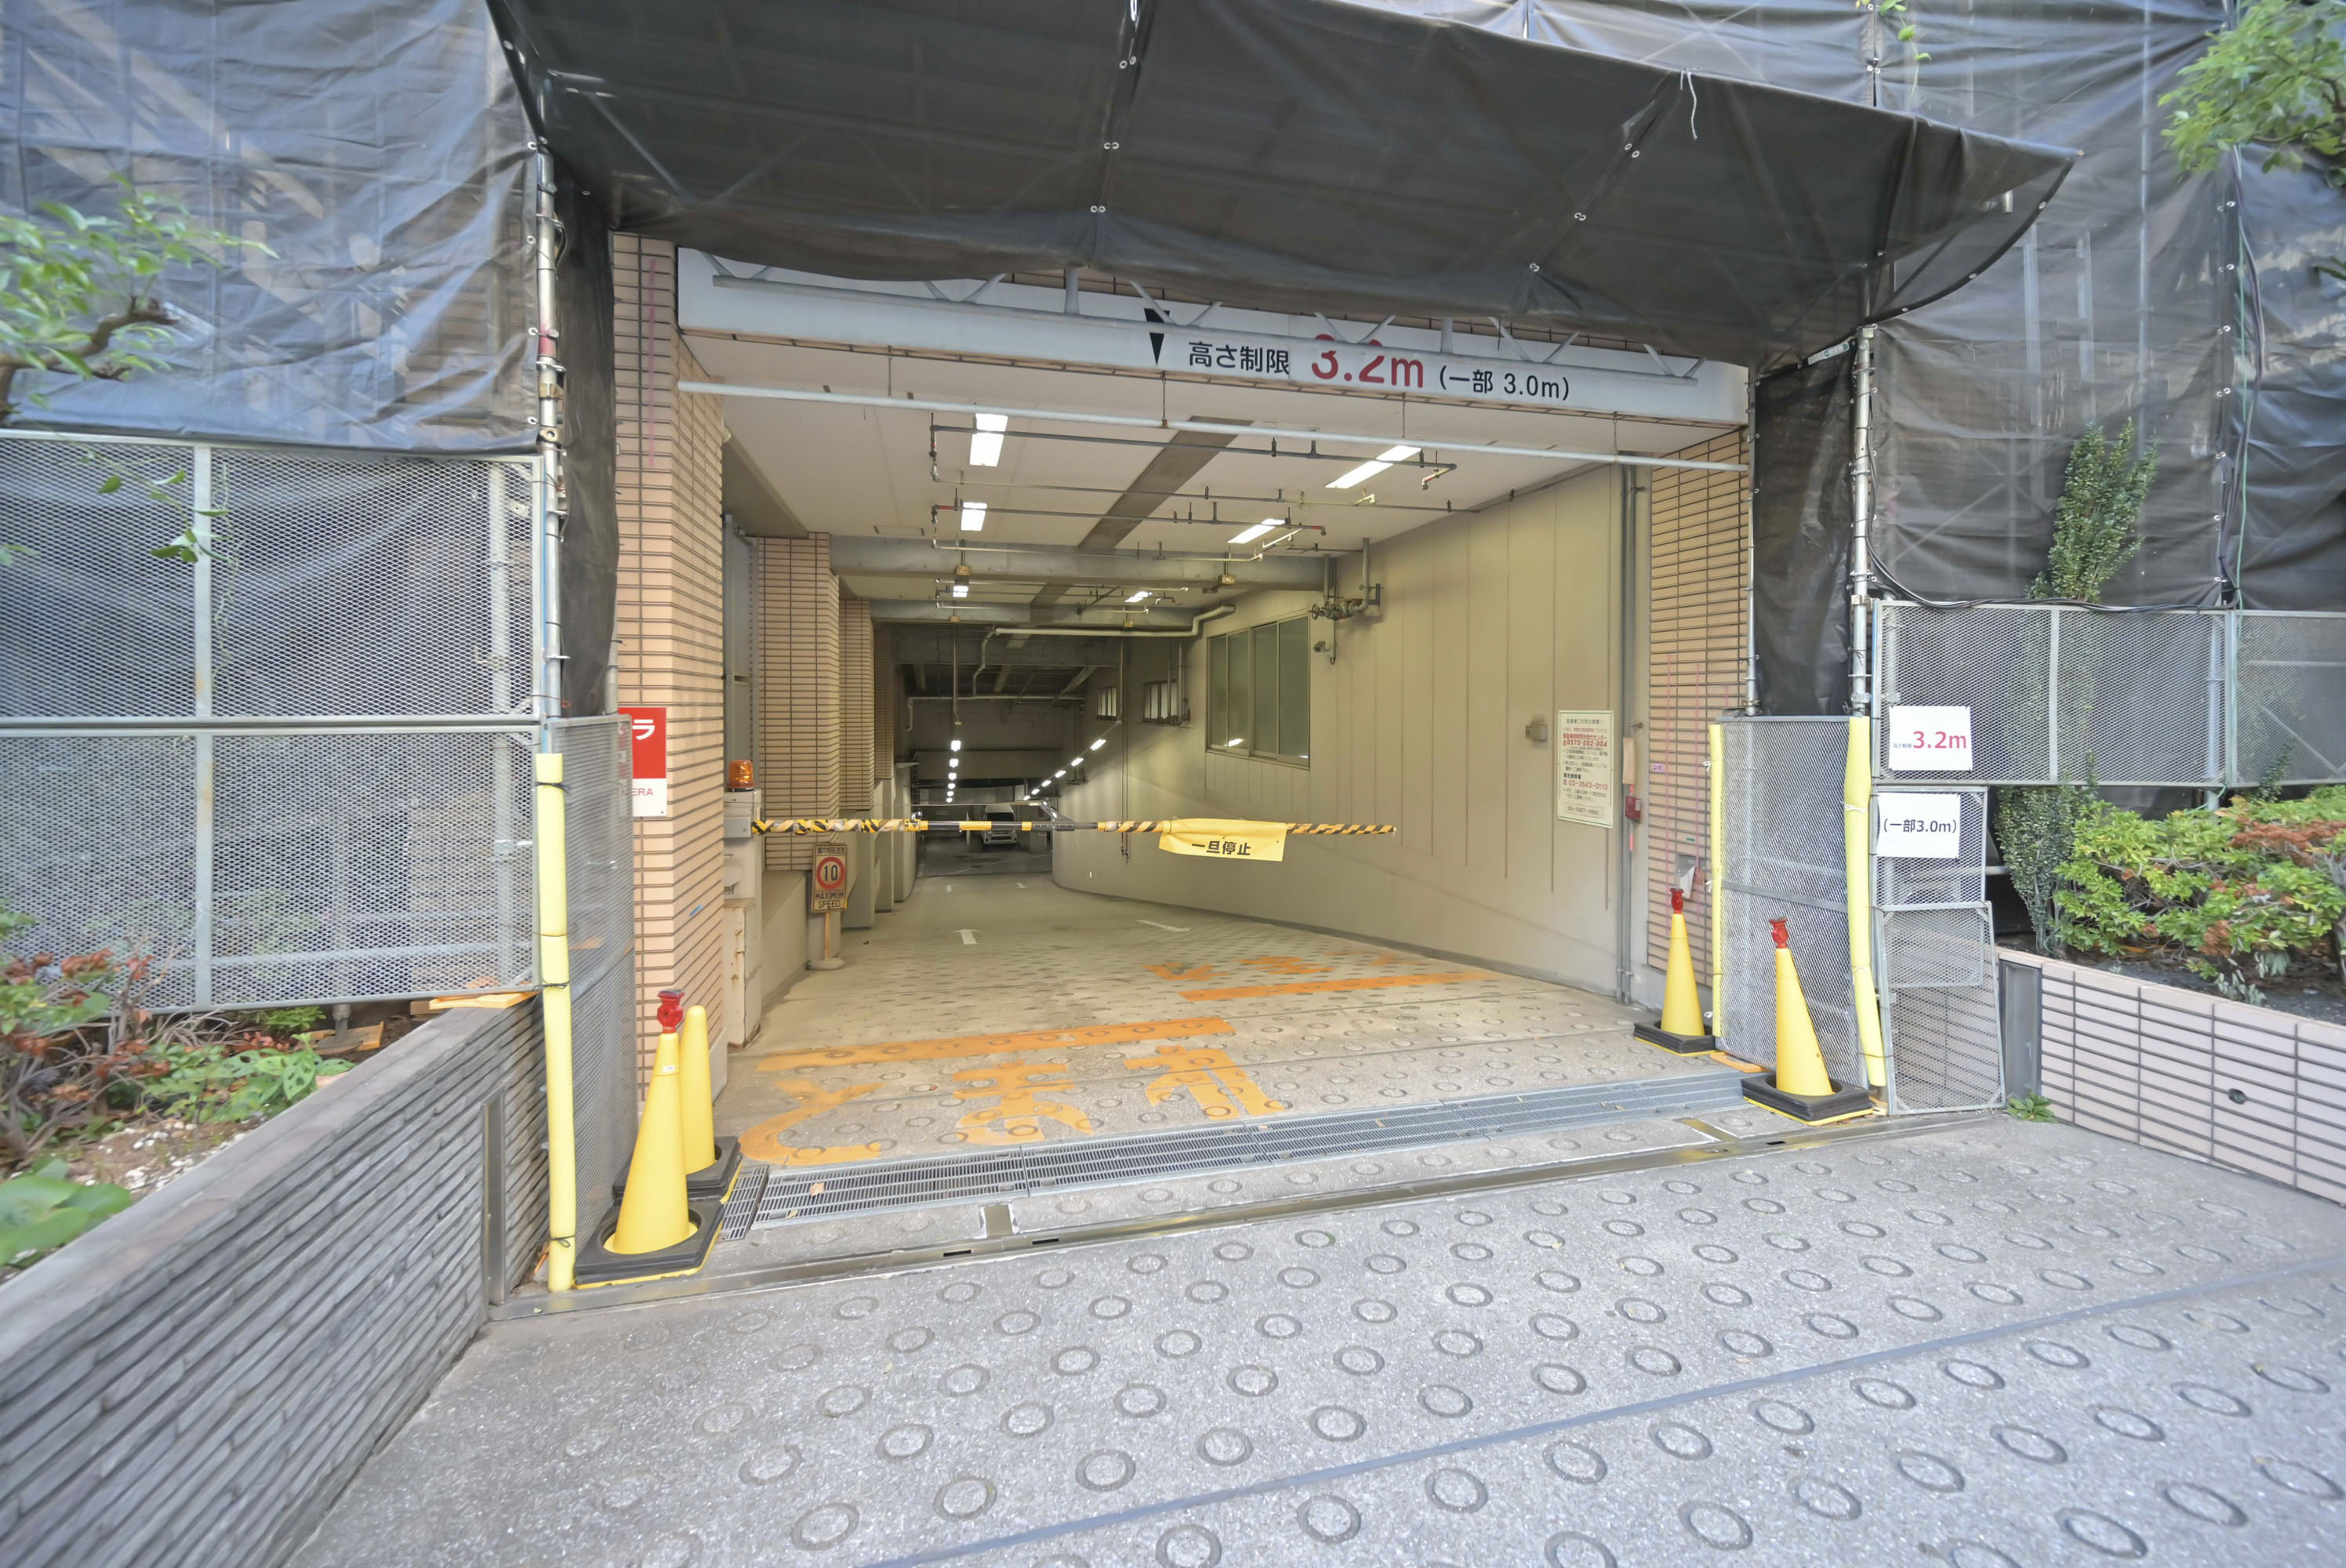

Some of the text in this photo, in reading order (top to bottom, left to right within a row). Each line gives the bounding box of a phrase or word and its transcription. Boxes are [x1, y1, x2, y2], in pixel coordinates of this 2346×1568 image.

[1188, 341, 1290, 376] 高さ制限
[1912, 731, 1966, 749] 3.2m
[1883, 818, 1957, 833] (一部3.0m)
[1191, 840, 1251, 856] 一旦停止
[824, 865, 838, 882] 10
[815, 891, 844, 901] MAXIMUM
[818, 900, 841, 909] SPEED
